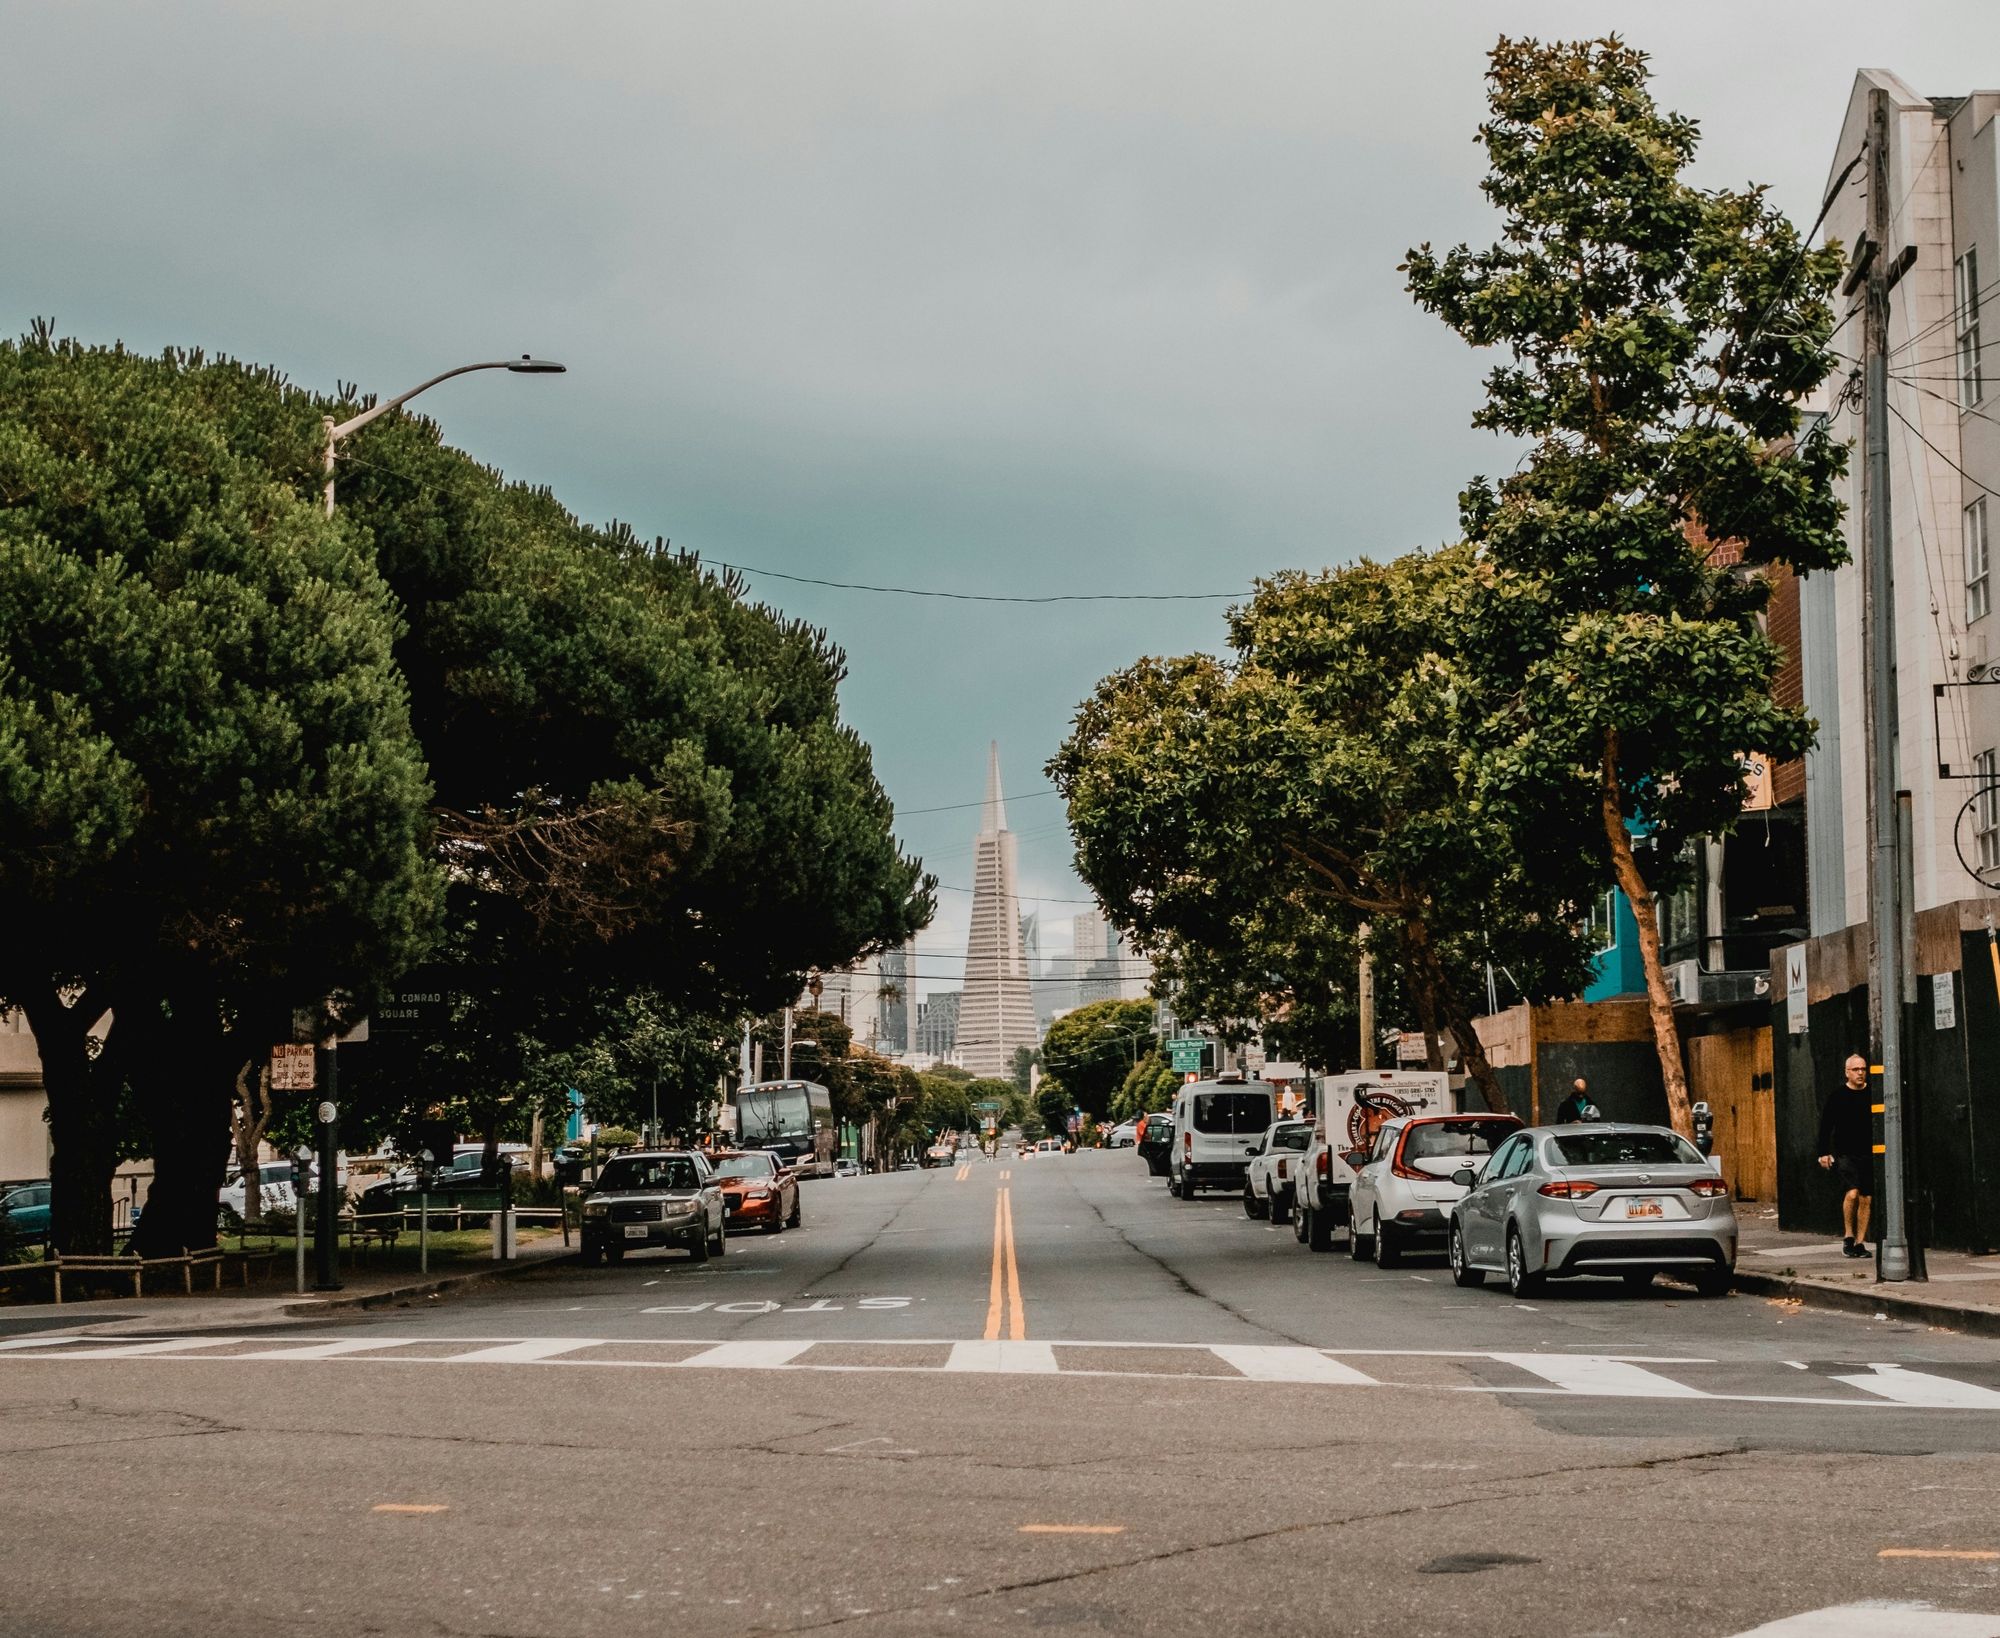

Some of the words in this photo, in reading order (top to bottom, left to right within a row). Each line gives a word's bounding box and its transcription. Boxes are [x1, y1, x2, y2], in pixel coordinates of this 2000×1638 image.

[1743, 759, 1765, 776] ES
[401, 993, 441, 1003] CONRAD
[379, 1009, 419, 1019] SQUARE
[273, 1045, 284, 1058] NO
[286, 1047, 312, 1057] PARKING
[639, 1296, 912, 1314] STOP
